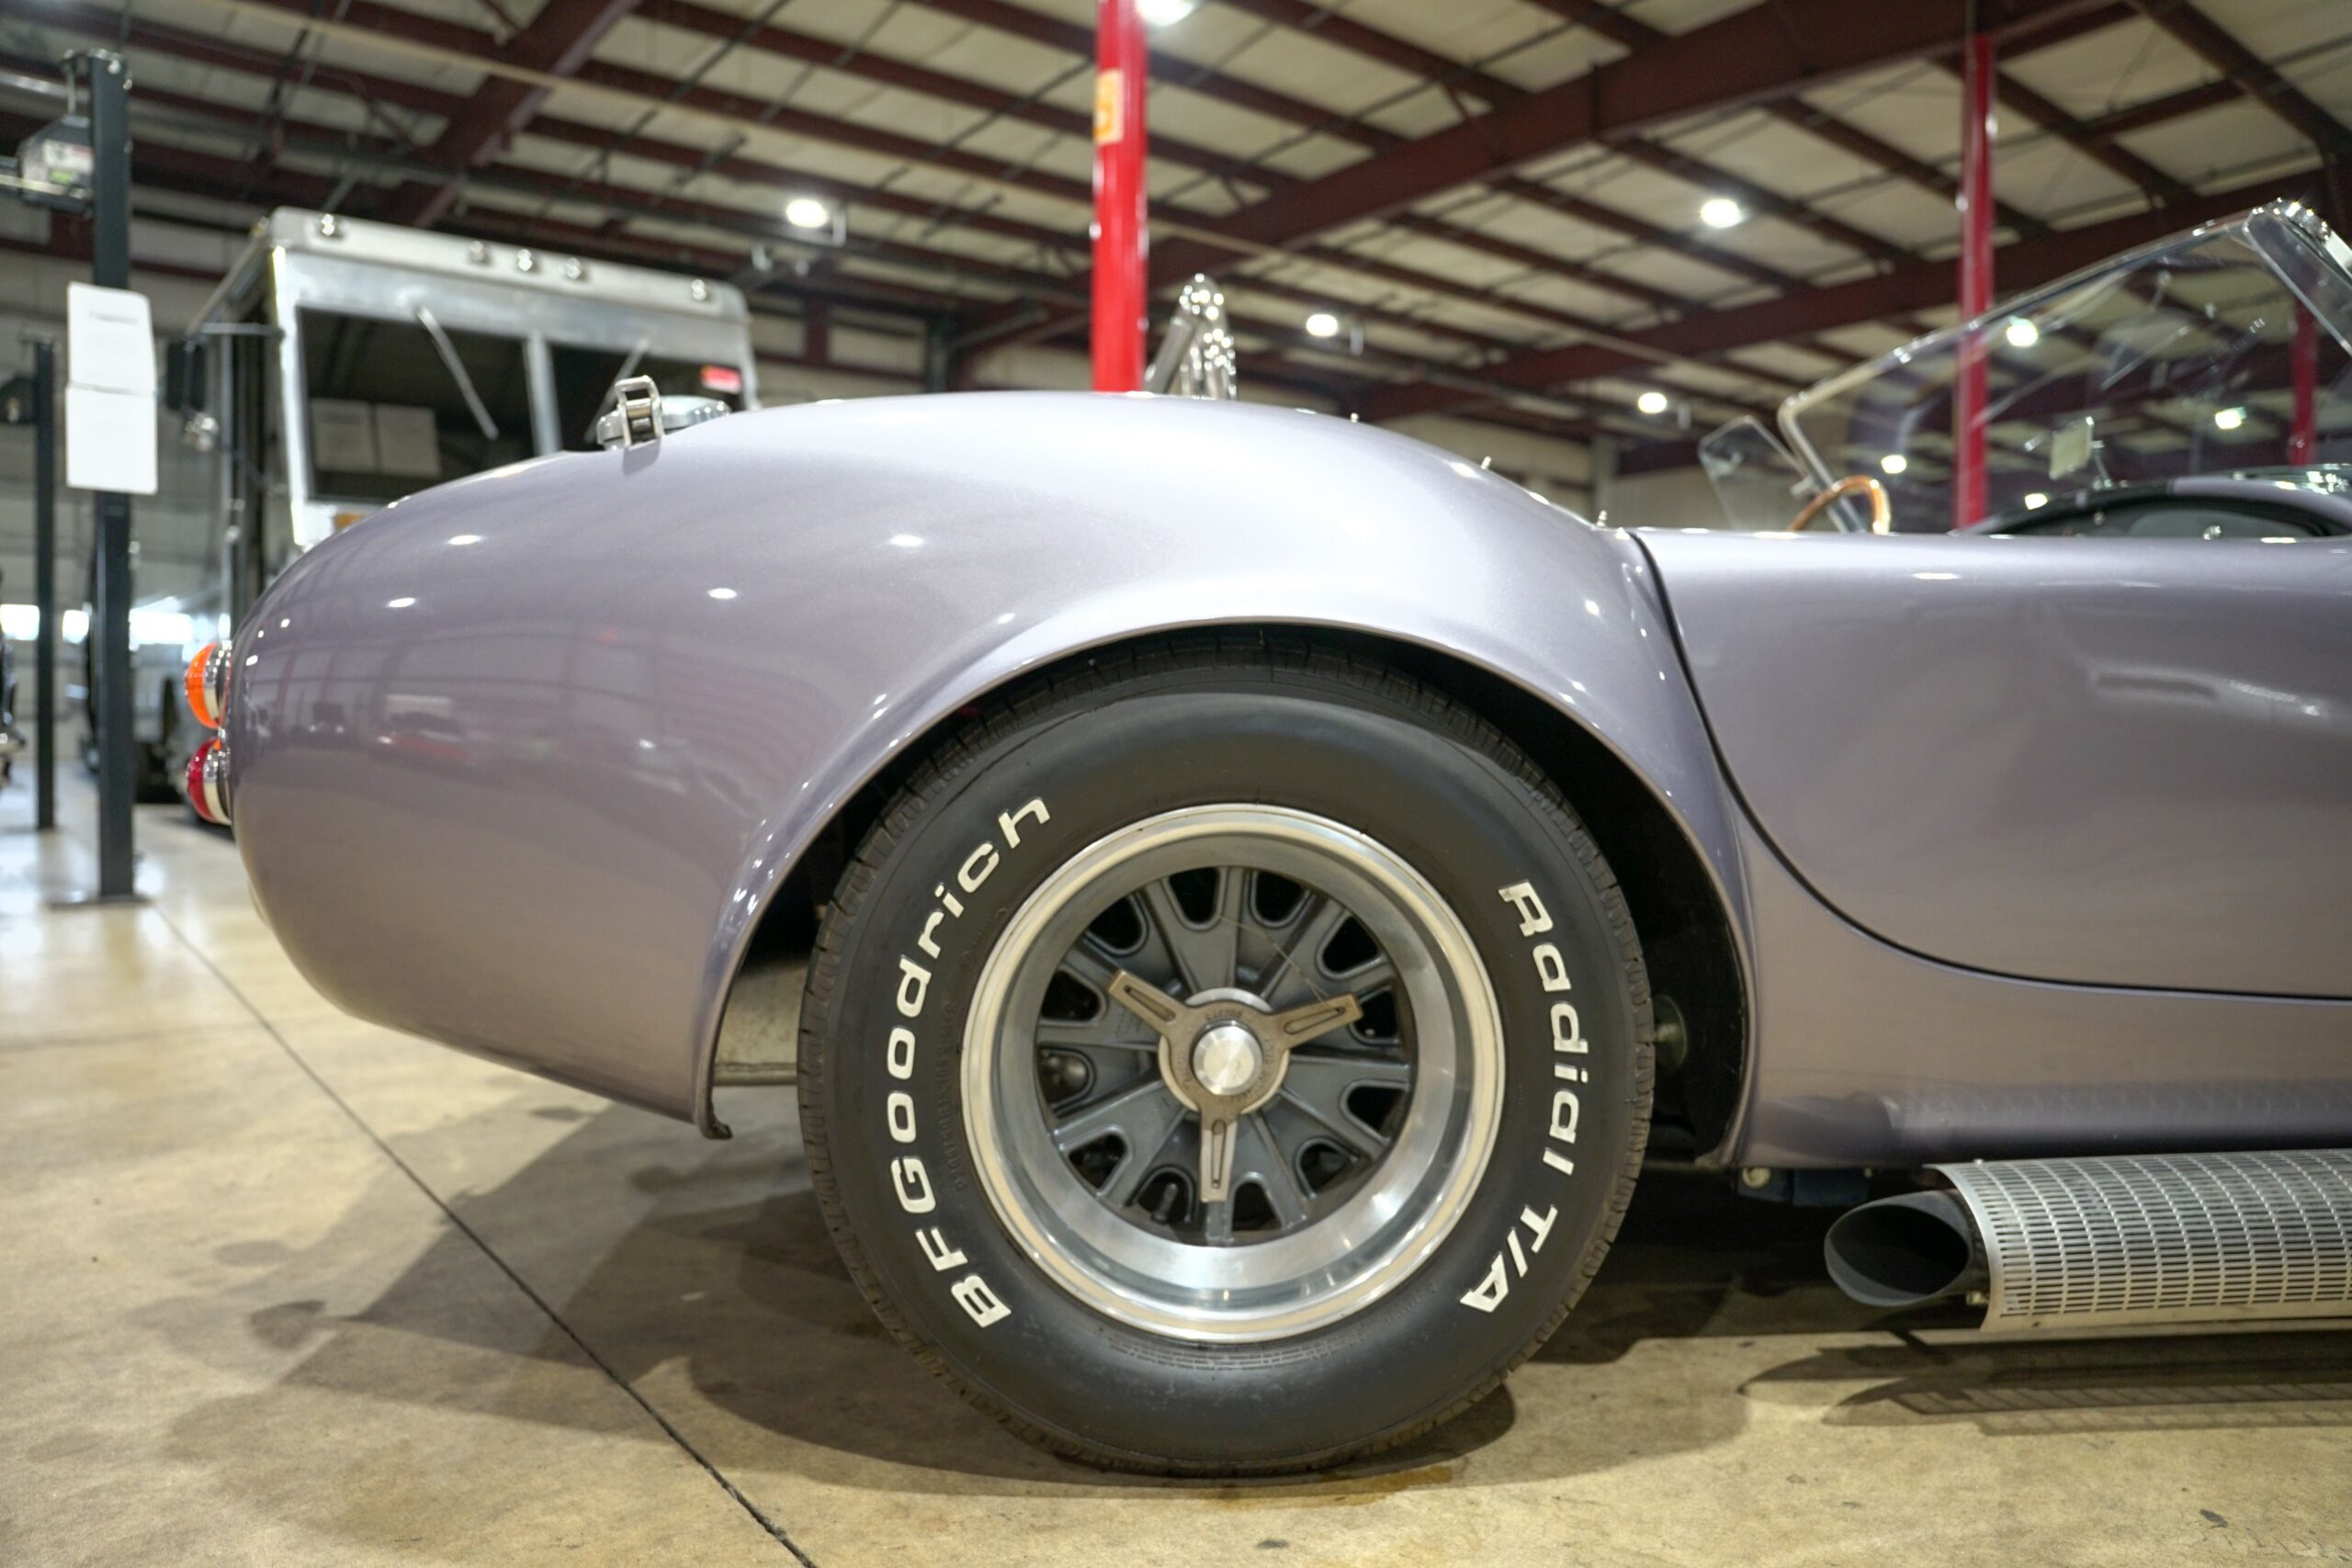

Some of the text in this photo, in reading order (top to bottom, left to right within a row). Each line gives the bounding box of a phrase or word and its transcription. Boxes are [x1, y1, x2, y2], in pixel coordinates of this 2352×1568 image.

[887, 797, 1051, 1328] BFGoodrich
[1459, 881, 1589, 1314] Radial T/A
